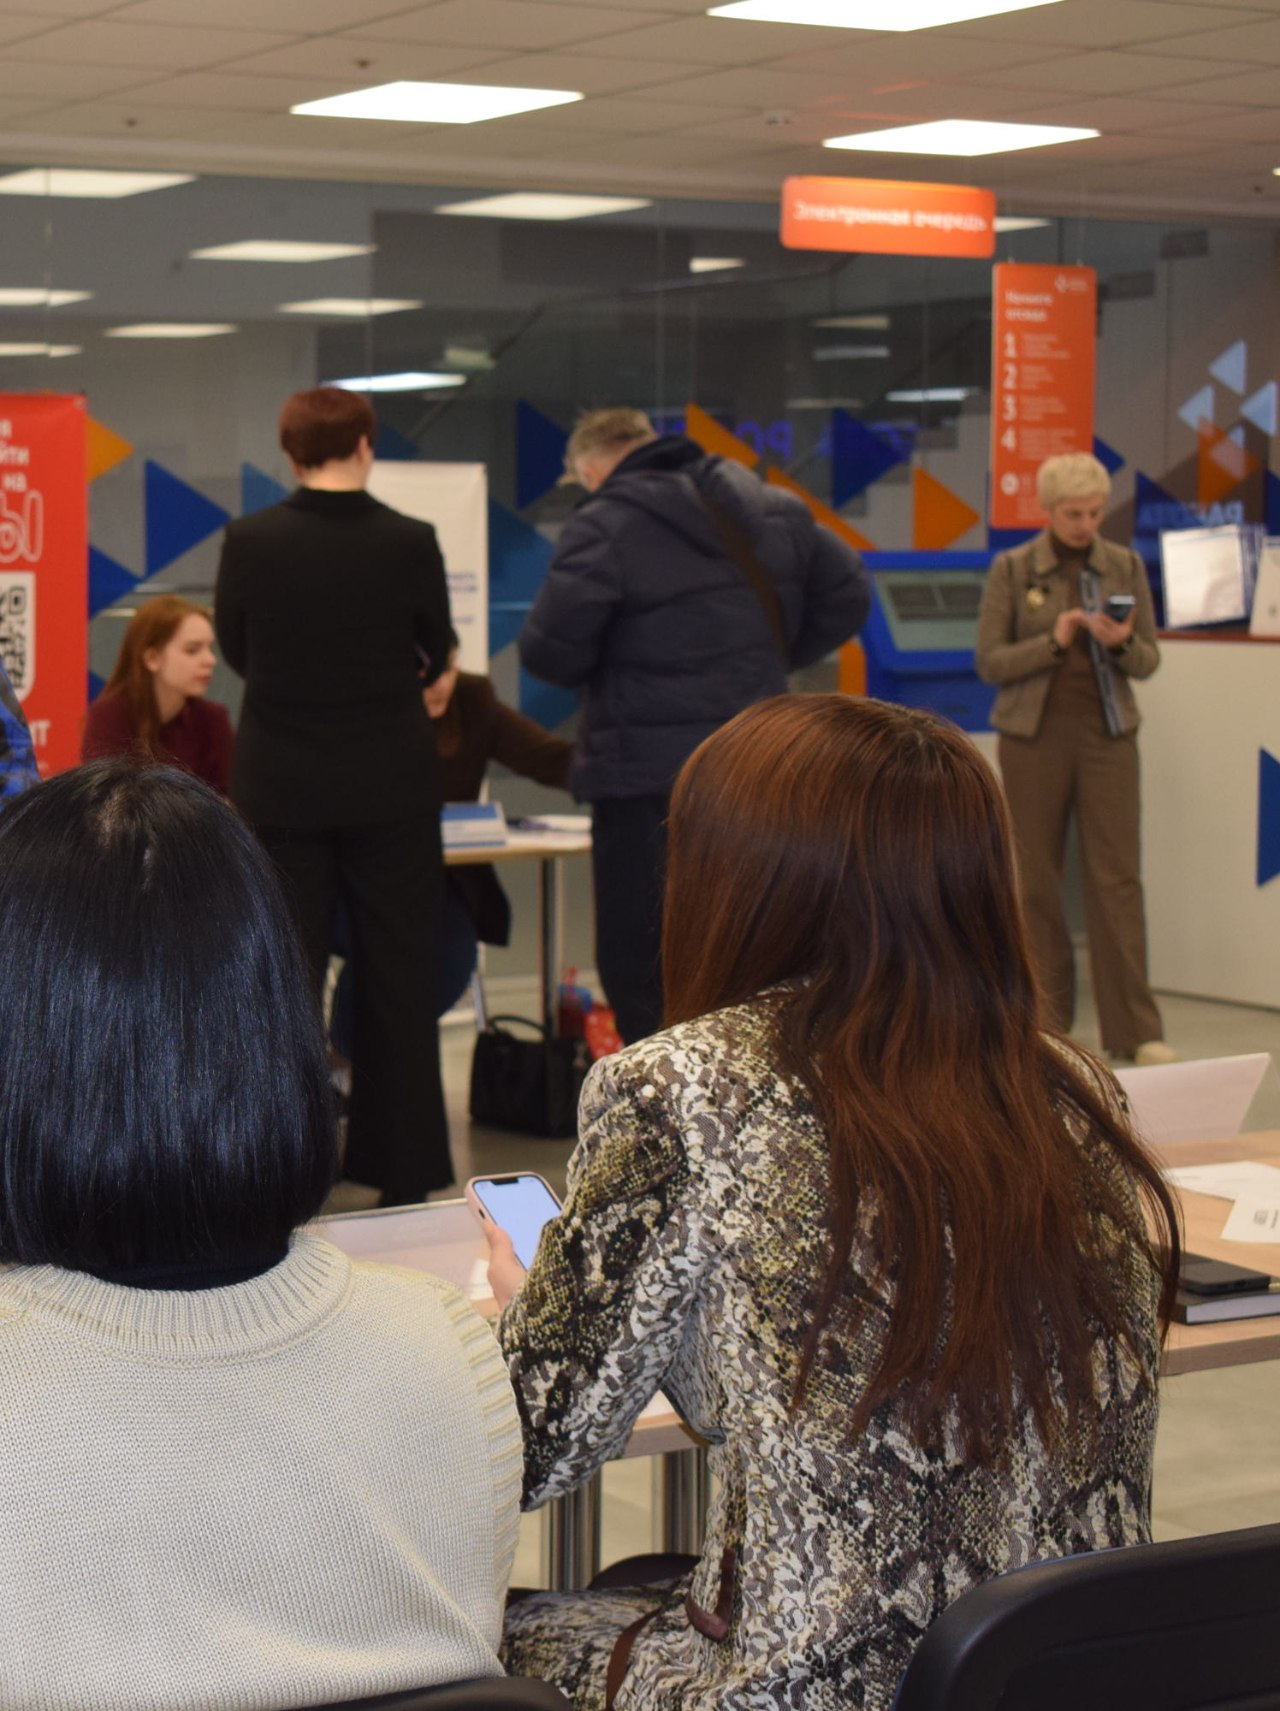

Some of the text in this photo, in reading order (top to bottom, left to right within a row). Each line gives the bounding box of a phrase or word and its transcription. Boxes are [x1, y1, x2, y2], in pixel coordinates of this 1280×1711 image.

[794, 203, 987, 232] Электронная очередь
[1004, 332, 1018, 358] 1
[1003, 365, 1018, 389] 2
[1001, 426, 1018, 449] 4
[2, 474, 27, 492] на
